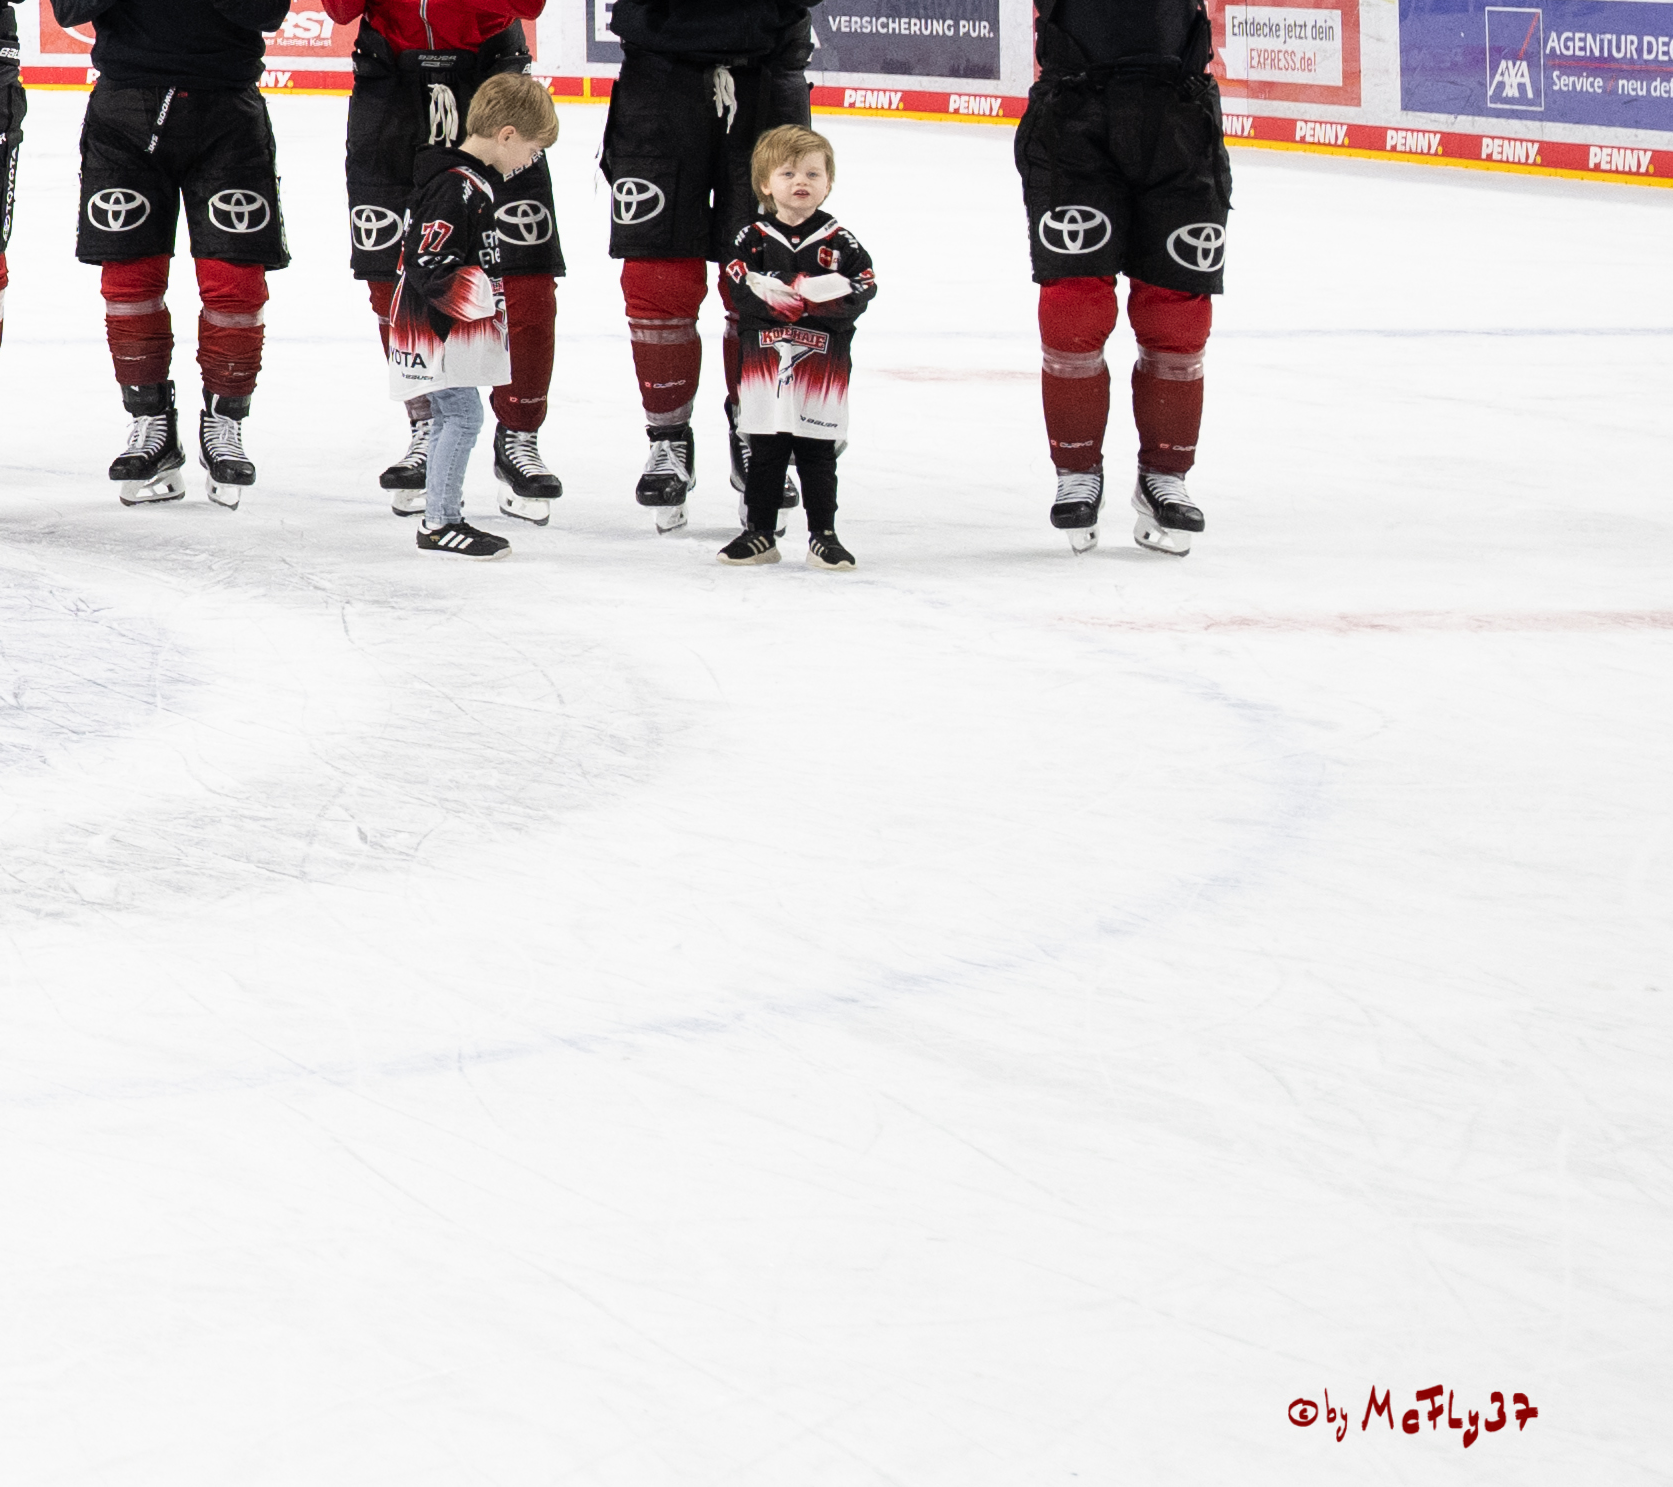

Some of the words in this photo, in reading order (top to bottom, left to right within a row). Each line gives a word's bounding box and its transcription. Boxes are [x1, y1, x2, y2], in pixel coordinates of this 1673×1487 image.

[828, 15, 954, 37] VERSICHERUNG
[959, 19, 994, 38] PUR.
[1231, 15, 1281, 39] Entdecke
[1283, 19, 1308, 42] jetzt
[1310, 22, 1335, 42] dein
[1546, 31, 1639, 60] AGENTUR
[1249, 48, 1316, 74] EXPRESS.de!
[1490, 60, 1534, 99] AXA
[1552, 70, 1603, 93] Service
[1618, 79, 1645, 96] neu
[419, 219, 454, 255] 77
